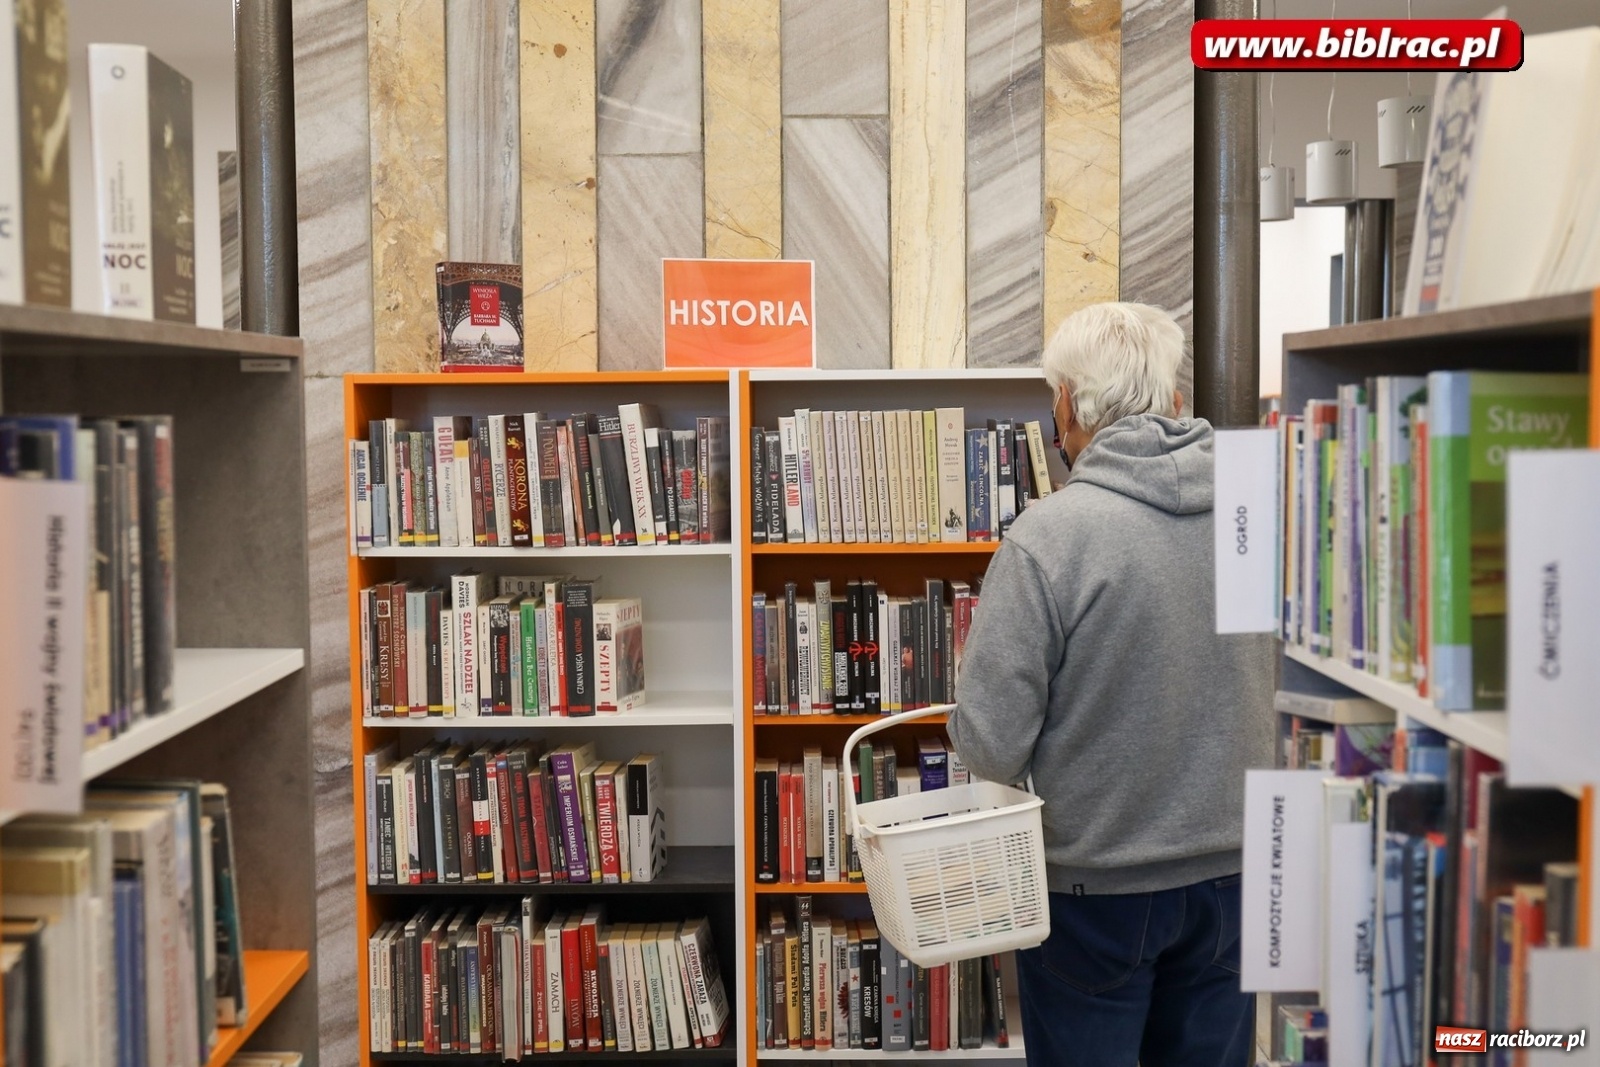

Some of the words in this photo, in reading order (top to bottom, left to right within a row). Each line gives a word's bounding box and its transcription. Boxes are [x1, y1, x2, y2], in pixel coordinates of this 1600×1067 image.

[102, 253, 146, 270] NOC
[668, 299, 808, 326] HISTORIA
[599, 421, 621, 432] Hitler
[1486, 404, 1572, 442] Stawy
[356, 448, 366, 470] AKCJA
[438, 427, 453, 463] GUŁAG
[543, 438, 556, 474] POMPEJE
[628, 423, 641, 476] BURZLIWY
[357, 472, 368, 502] OCALENIE
[482, 458, 492, 492] OBLICZE
[494, 463, 506, 498] RYCERZE
[508, 458, 518, 512] PLANTAGENETÓW
[514, 458, 527, 510] KORONA
[784, 454, 800, 507] HITLERLAND
[803, 460, 812, 484] PRAWDY
[485, 496, 493, 512] ZŁA
[634, 477, 645, 504] WIEK
[638, 505, 647, 519] XX
[772, 483, 780, 533] FIDELADA
[1236, 504, 1248, 555] OGRÓD
[463, 612, 472, 646] SZLAK
[575, 618, 583, 653] KOMUNIZMU
[380, 646, 390, 680] KRESY
[464, 649, 473, 694] NADZIEI
[538, 647, 547, 668] KOBIETY
[576, 653, 584, 672] KSIĘGA
[600, 645, 610, 694] SZEPTY
[820, 620, 832, 691] ZMARTWYCHWSTANIE
[538, 669, 548, 704] SOLIDARNOŚCI
[577, 672, 585, 694] CZARNA
[515, 772, 524, 793] CIEMNA
[517, 796, 526, 818] STRONA
[564, 795, 576, 826] IMPERIUM
[599, 801, 613, 850] TWIERDZA
[1272, 795, 1285, 870] KWIATOWE
[568, 827, 578, 861] OSMAŃSKIE
[1269, 872, 1284, 968] KOMPOZYCJE
[1355, 920, 1369, 975] SZTUKA
[688, 943, 701, 979] CZERWONA
[697, 980, 707, 1004] ZARAZA
[551, 972, 560, 1013] ZAMACH
[616, 979, 625, 1005] ŻOŁNIERZE
[634, 980, 643, 1006] ŻOŁNIERZE
[650, 978, 661, 1004] ŻOŁNIERZE
[570, 998, 580, 1028] LWÓW
[636, 1008, 645, 1029] WYKLĘCI
[654, 1006, 663, 1027] WYKLĘCI
